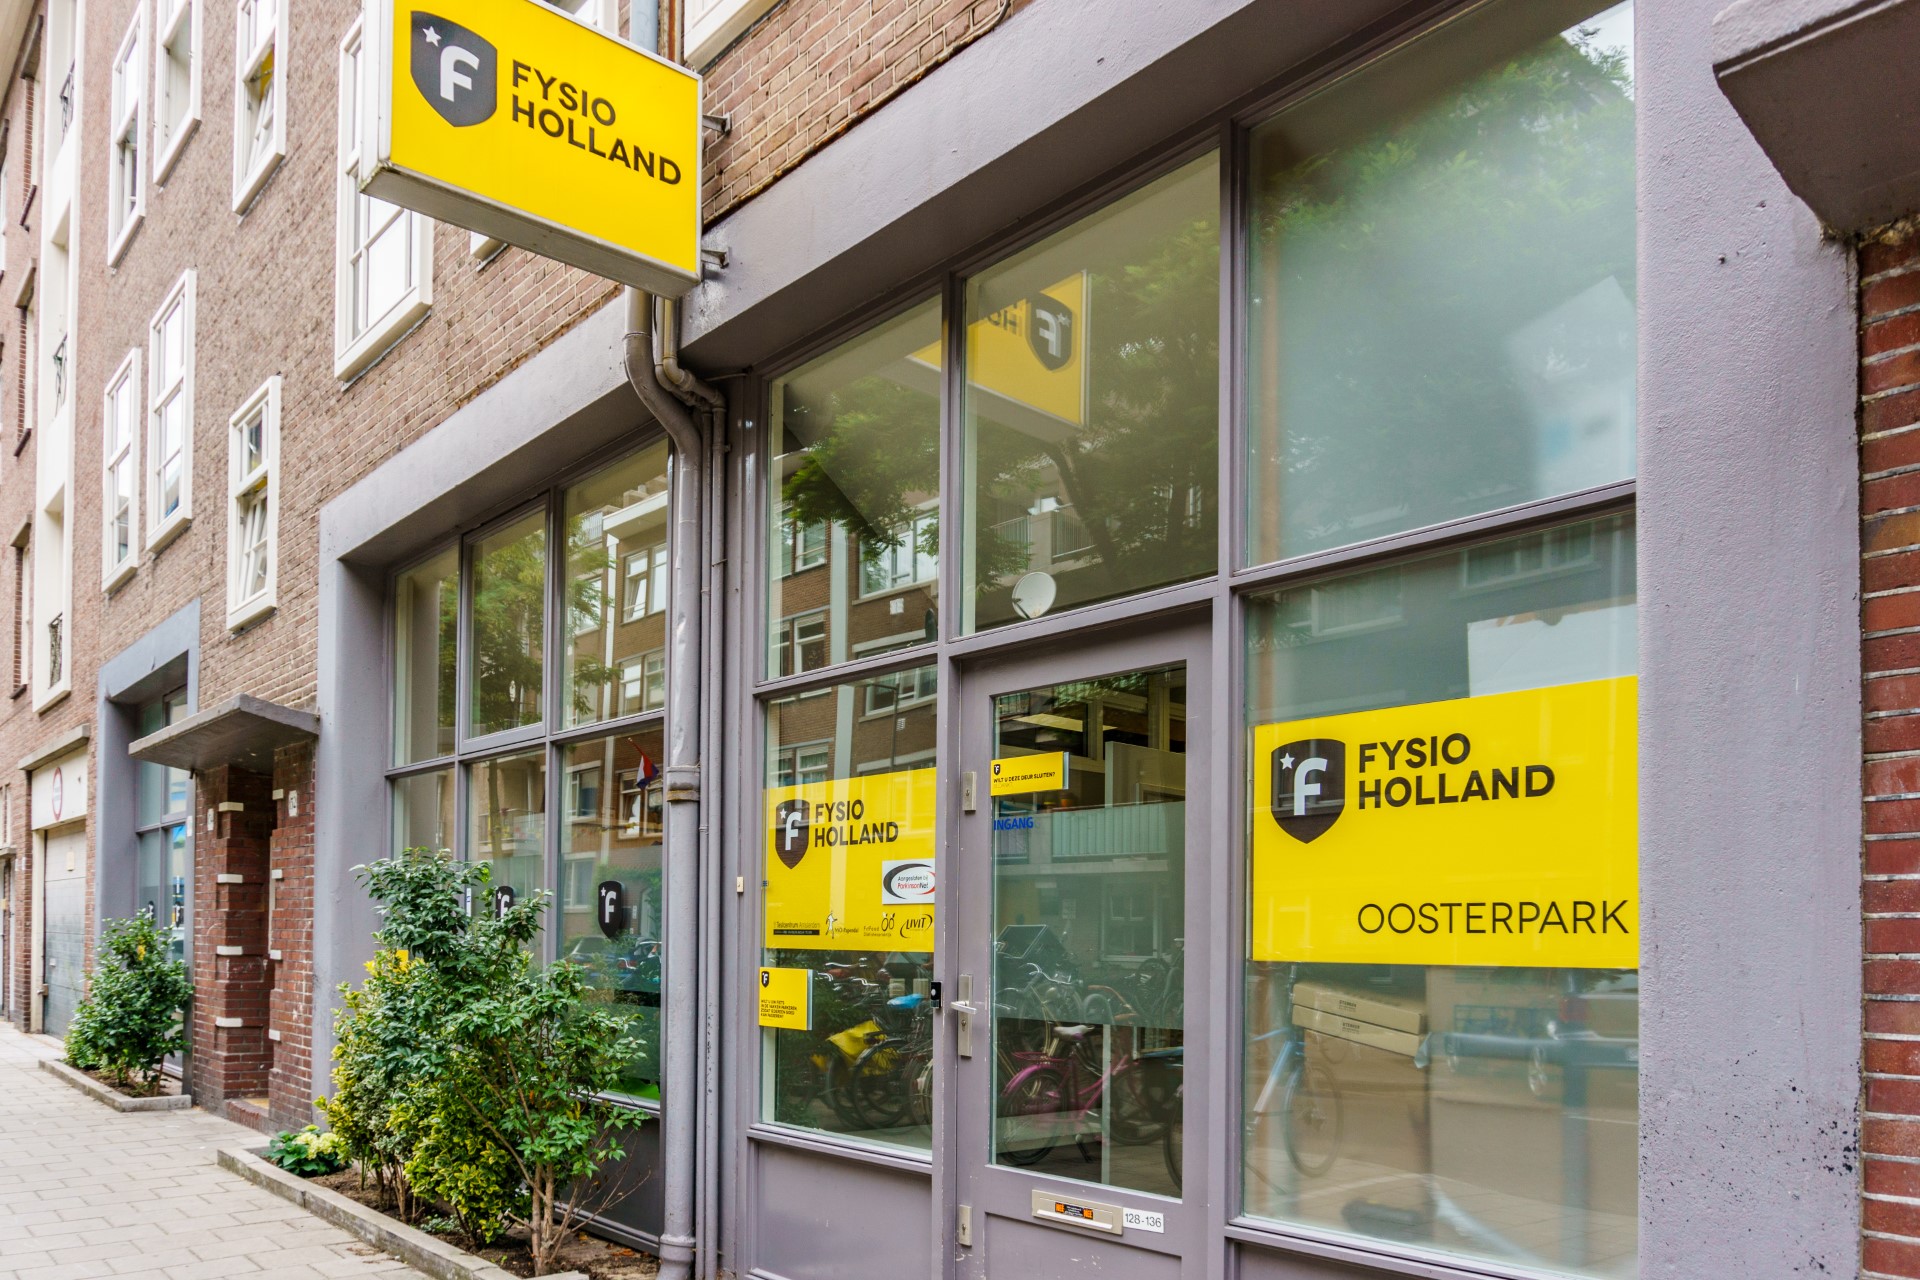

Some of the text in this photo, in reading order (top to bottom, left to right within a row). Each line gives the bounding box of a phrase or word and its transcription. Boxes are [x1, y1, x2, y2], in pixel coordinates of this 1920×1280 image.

[512, 59, 617, 127] FYSIO
[512, 95, 681, 185] HOLLAND
[1359, 733, 1471, 773] FYSIO
[1359, 764, 1555, 810] HOLLAND
[815, 800, 864, 823] FYSIO
[994, 817, 1034, 831] INGANG
[814, 822, 899, 847] HOLLAND
[906, 918, 926, 929] LIVIT
[1358, 900, 1630, 934] OOSTERPARK
